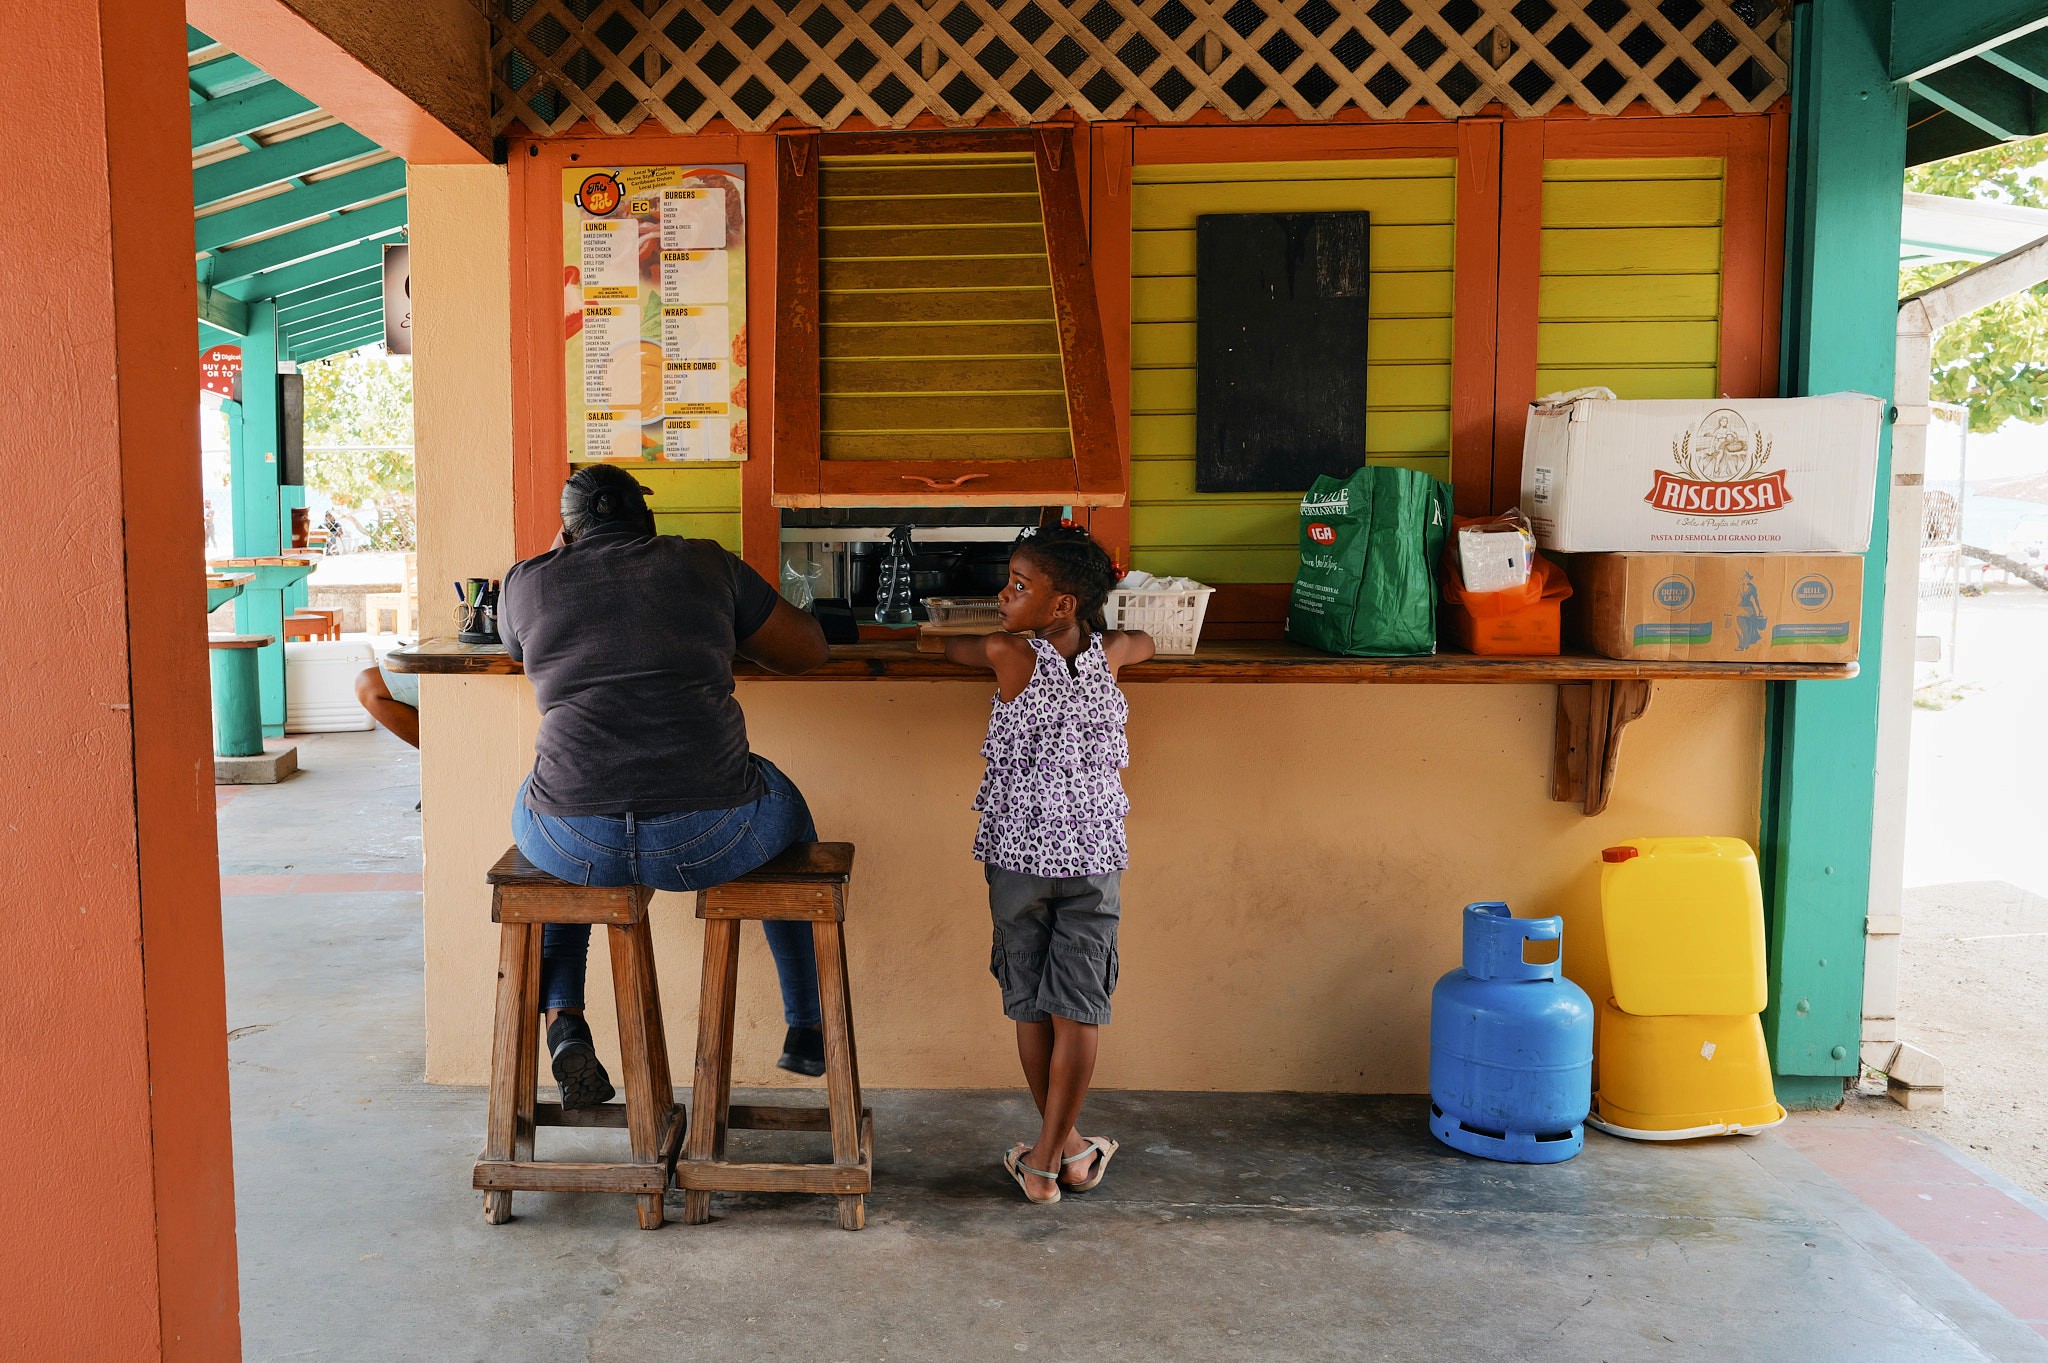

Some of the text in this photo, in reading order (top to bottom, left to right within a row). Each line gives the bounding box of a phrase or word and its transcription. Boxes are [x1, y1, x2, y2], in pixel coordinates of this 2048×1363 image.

[586, 181, 607, 195] The
[666, 191, 695, 199] BURGERS
[590, 192, 612, 210] Pot
[632, 202, 648, 211] EC
[585, 223, 607, 231] LUNCH
[586, 308, 612, 316] SNACKS
[588, 412, 613, 420] SALADS
[1662, 482, 1776, 510] RISCOSSA
[1682, 518, 1699, 526] Sole
[1707, 519, 1729, 530] Puglia
[1312, 527, 1332, 540] IGA
